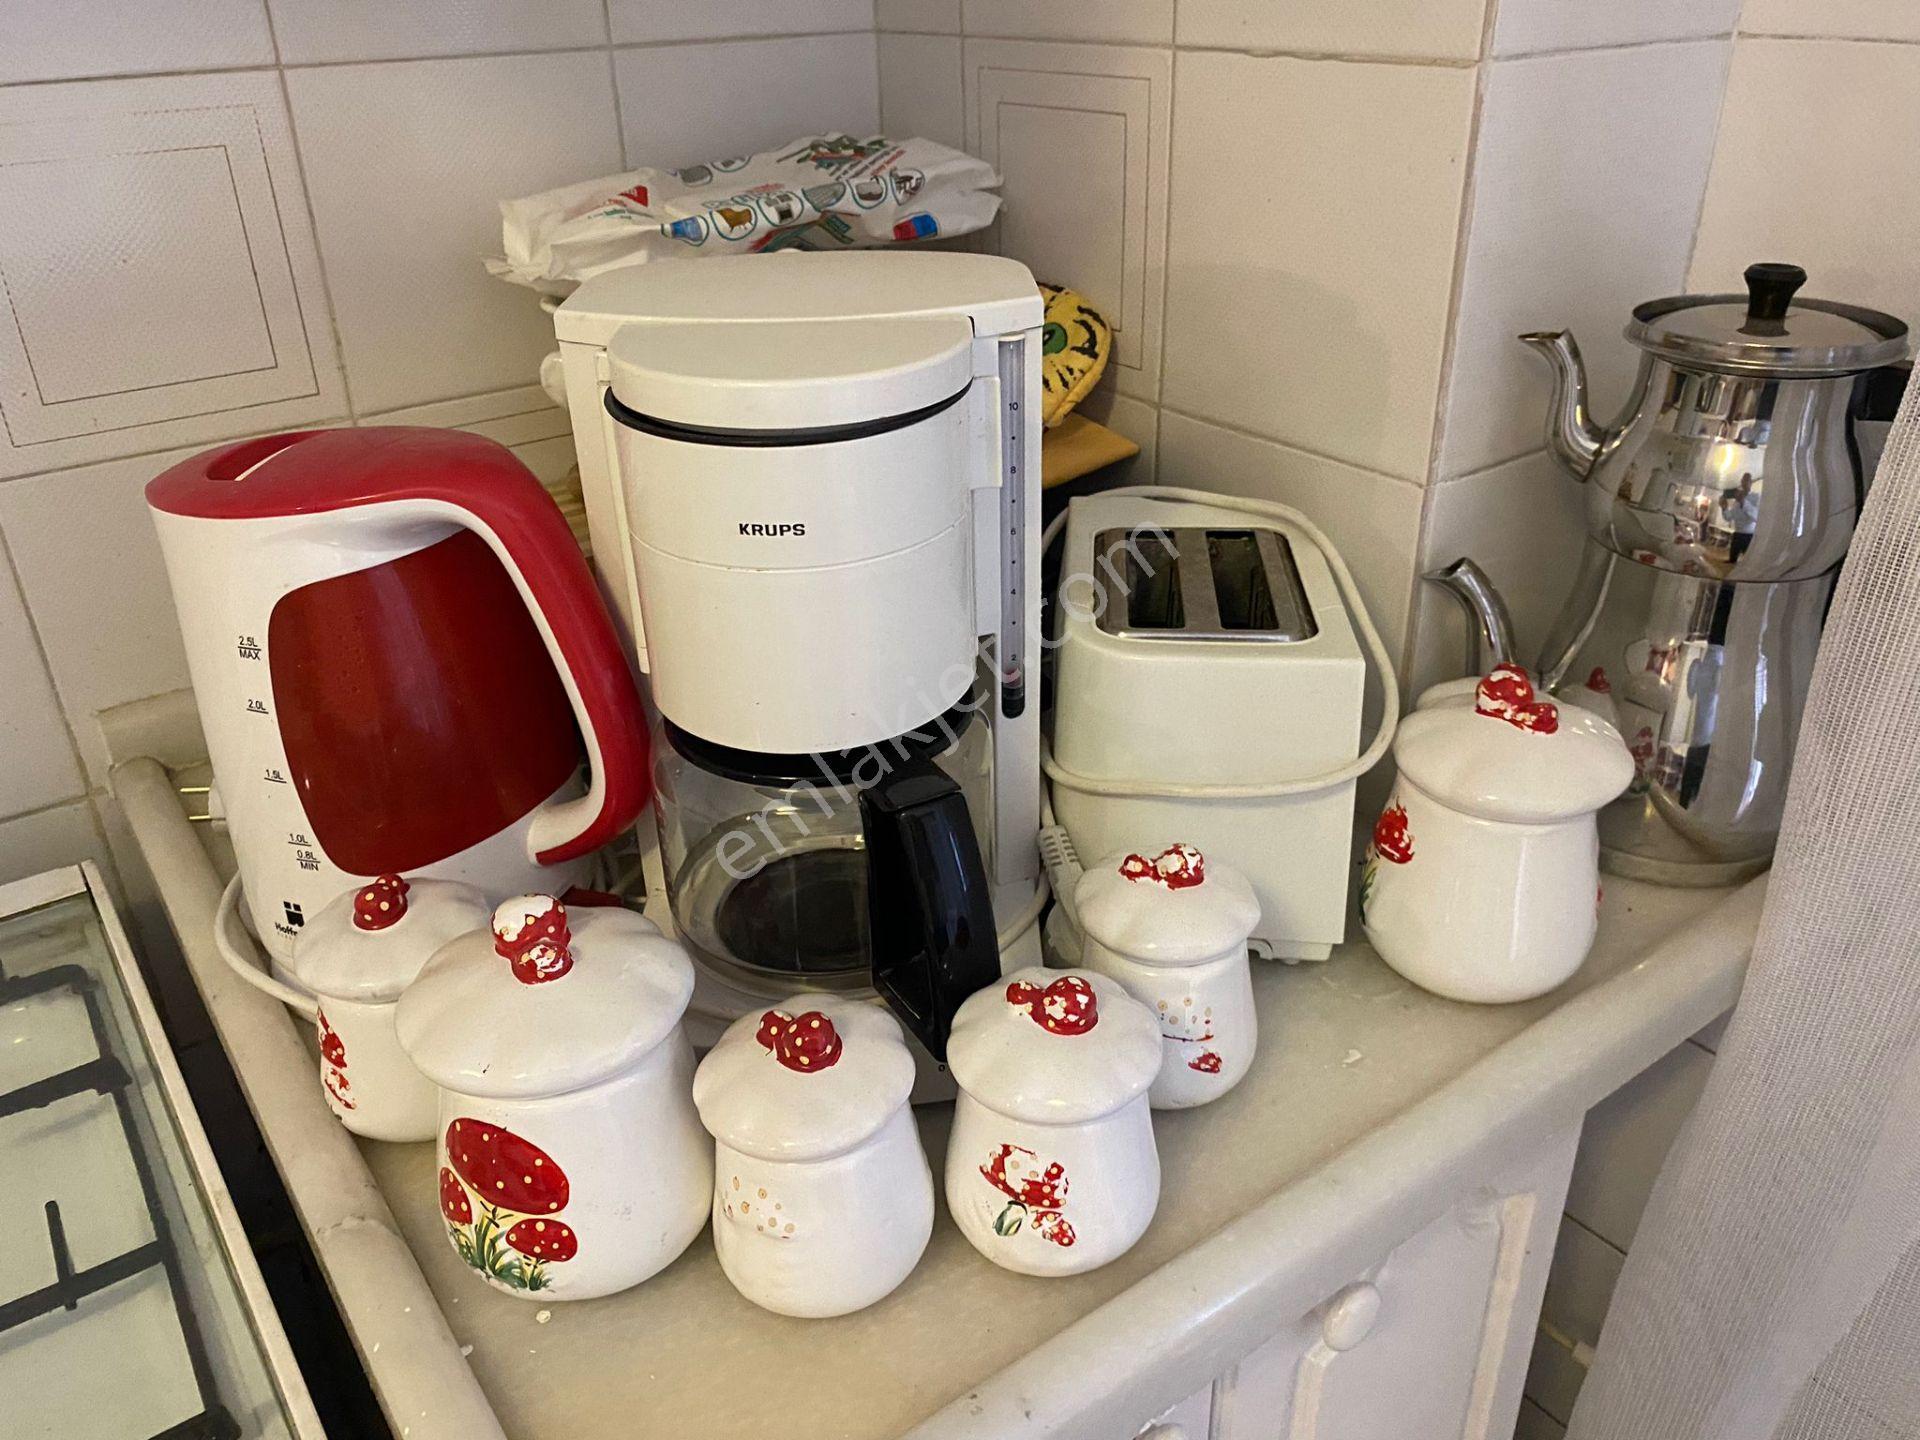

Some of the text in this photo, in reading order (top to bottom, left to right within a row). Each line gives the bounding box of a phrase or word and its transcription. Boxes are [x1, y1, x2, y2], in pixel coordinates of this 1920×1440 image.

[1009, 401, 1019, 411] 10
[1010, 465, 1017, 474] 8
[739, 523, 806, 536] KRUPS
[1010, 527, 1017, 536] 6
[238, 635, 258, 647] 2.5L
[239, 649, 261, 661] MAX
[1010, 653, 1017, 661] 2
[248, 699, 267, 711] 2.0L
[265, 768, 284, 780] 1.5L
[289, 833, 308, 844] 1.0L
[296, 849, 317, 861] 0.8L
[300, 861, 319, 872] MIN
